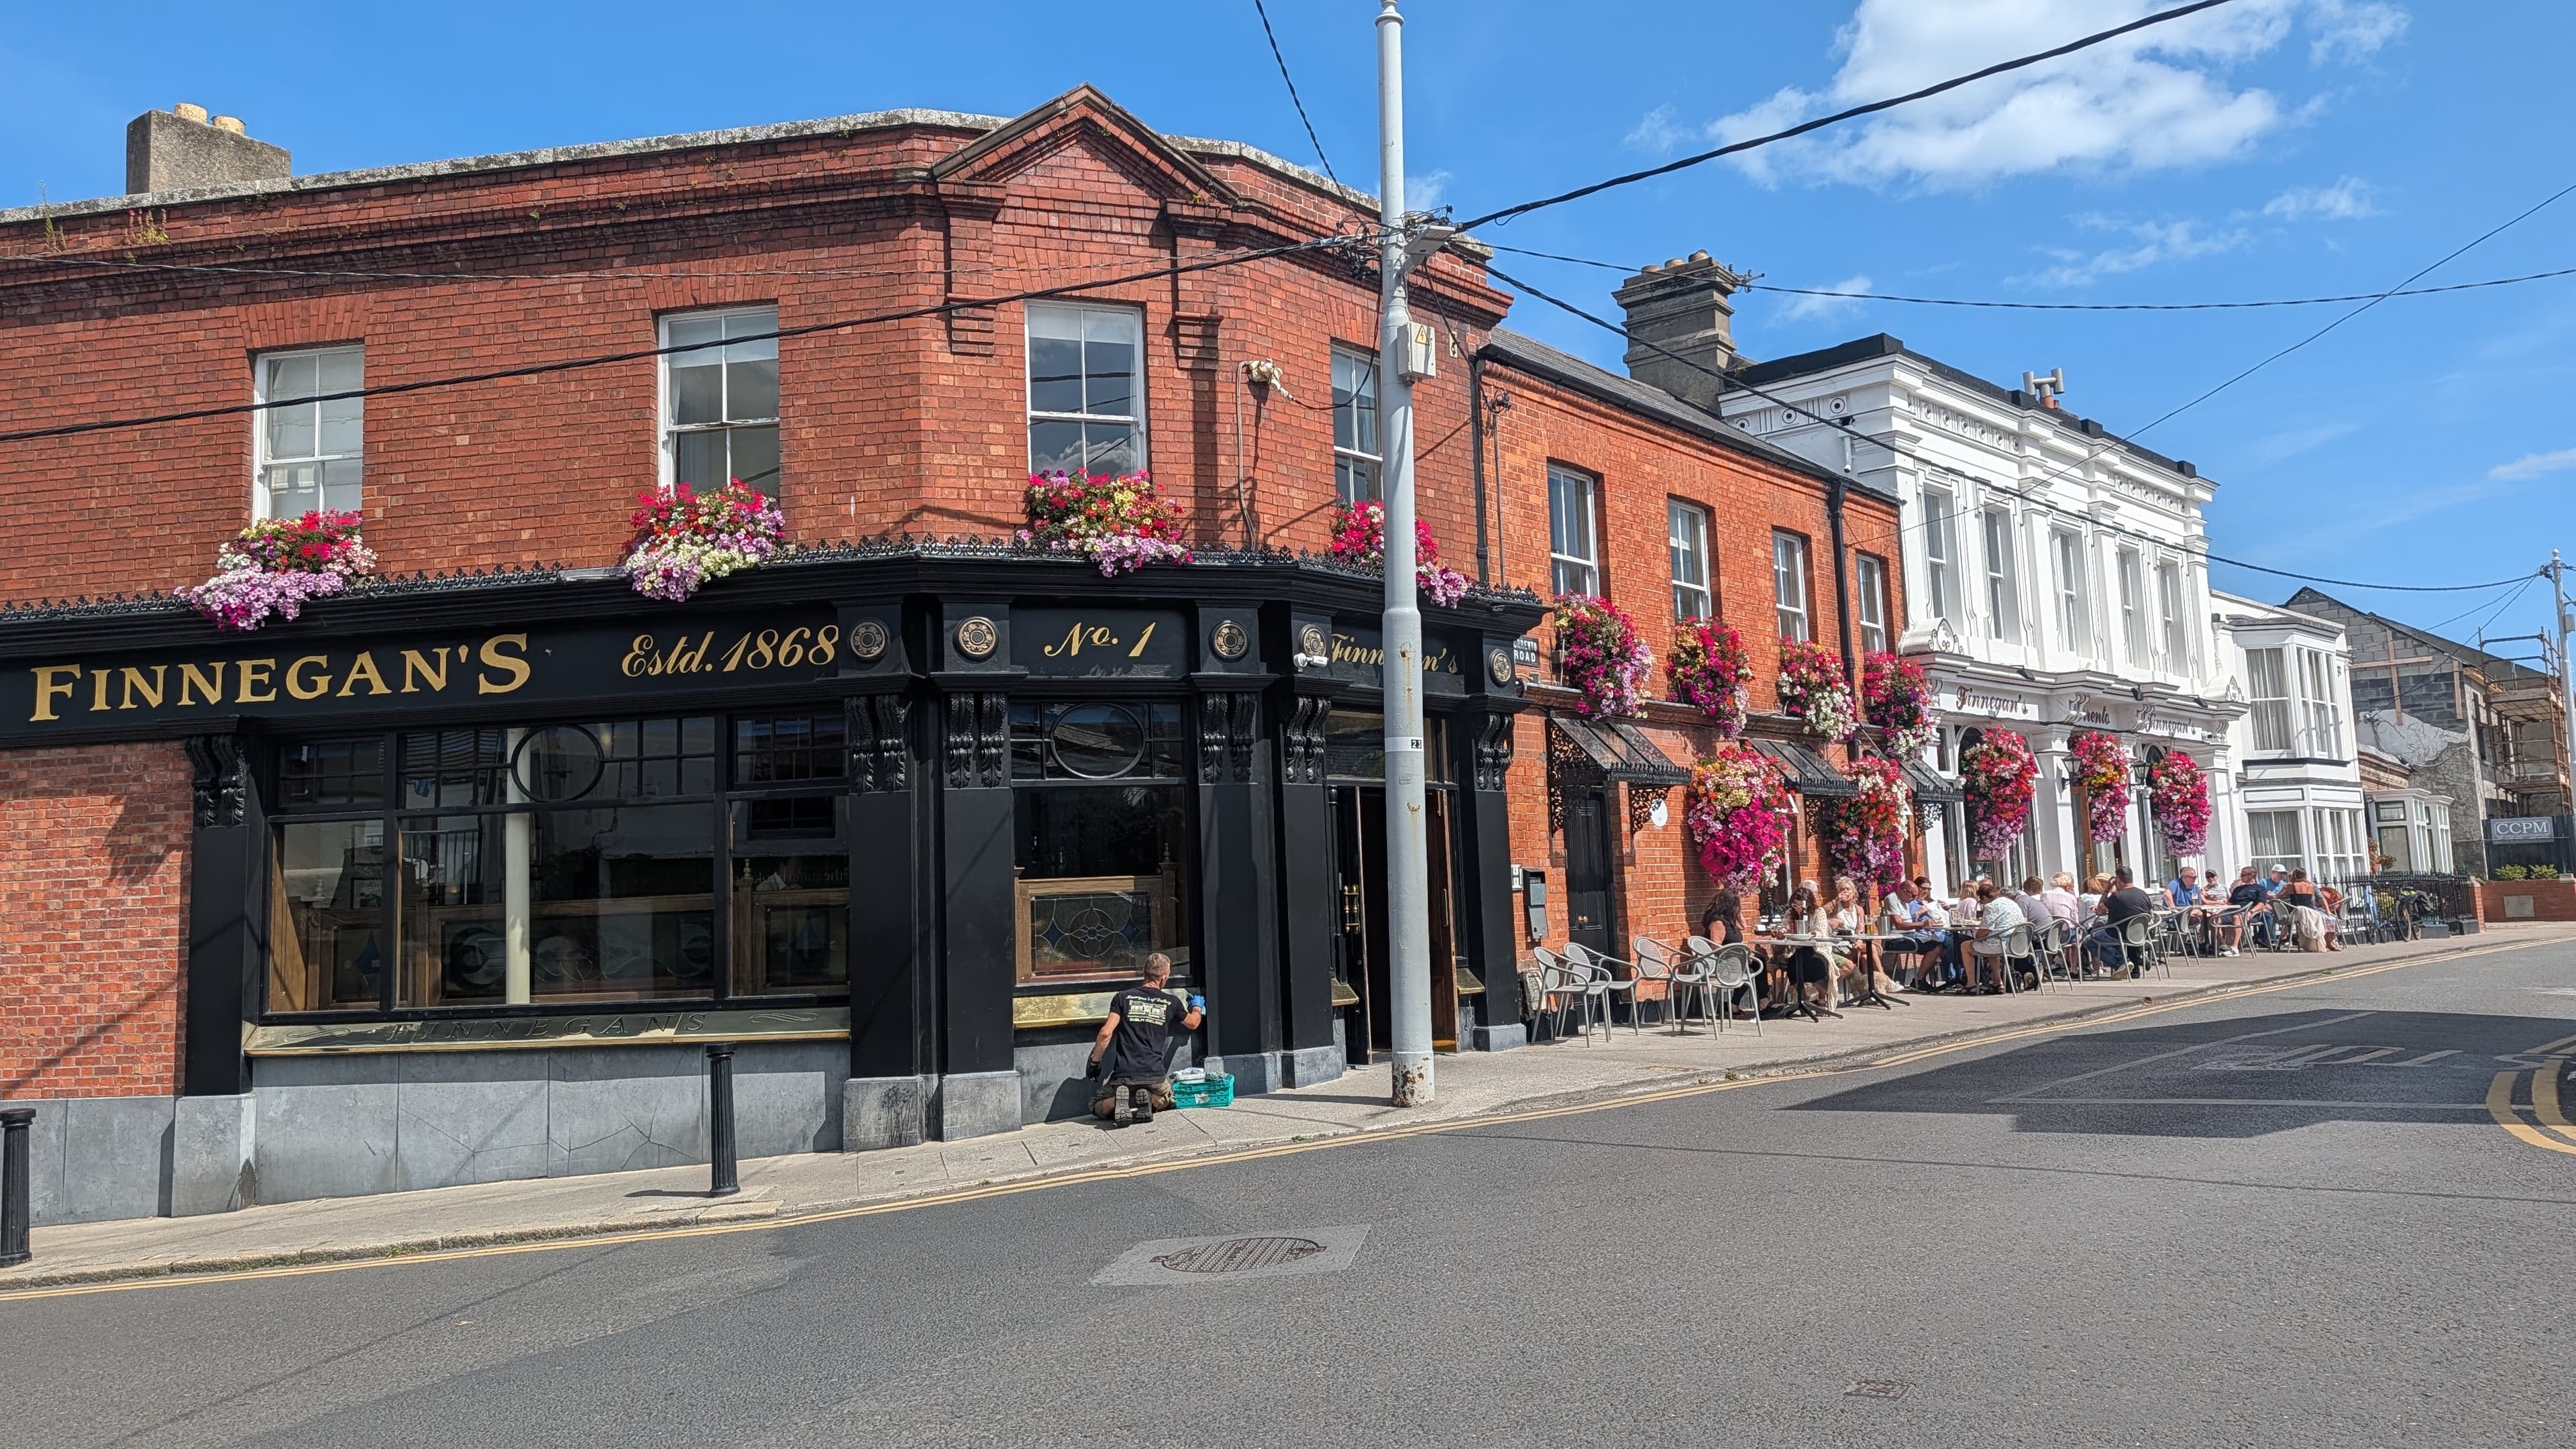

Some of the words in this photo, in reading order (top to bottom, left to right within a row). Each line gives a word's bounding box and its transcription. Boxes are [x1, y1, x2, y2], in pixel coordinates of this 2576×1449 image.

[622, 631, 715, 677] Estd.
[720, 625, 839, 672] 1868
[1044, 622, 1118, 657] No.
[1128, 622, 1156, 657] 1
[1331, 633, 1458, 674] Finnn's
[1513, 639, 1537, 651] ORRENTO
[1513, 649, 1536, 662] ROAD
[29, 633, 531, 722] FINNEGAN'S
[1956, 686, 2029, 716] Finnegan's
[2146, 712, 2196, 737] Finnegan's
[1411, 739, 1421, 749] 23
[2496, 821, 2548, 835] CCPM
[386, 1013, 707, 1042] FINNEGANS
